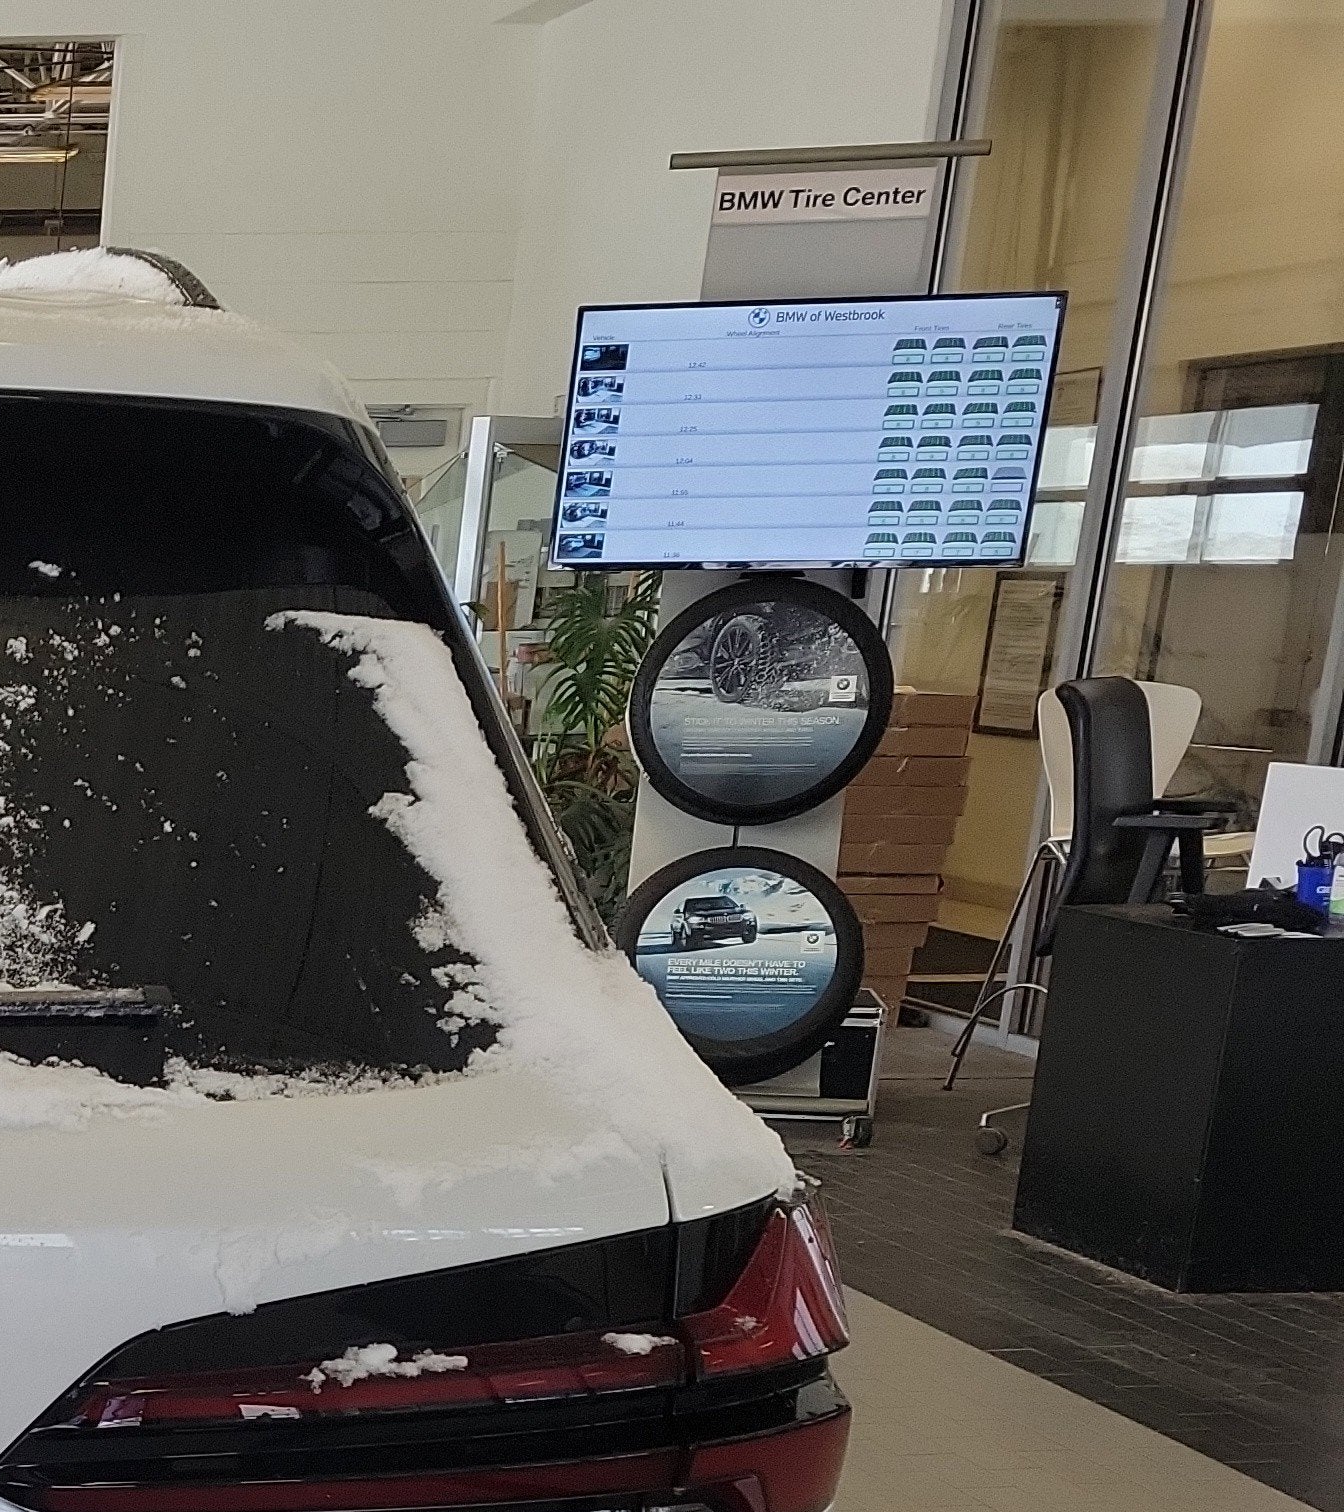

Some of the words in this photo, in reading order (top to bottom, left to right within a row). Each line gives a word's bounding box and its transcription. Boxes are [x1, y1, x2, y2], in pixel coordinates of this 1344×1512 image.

[719, 190, 785, 211] BMW
[789, 189, 835, 209] Tire
[842, 186, 927, 207] Center
[776, 311, 807, 322] BMW
[810, 310, 822, 322] of
[824, 309, 885, 321] Westbrook
[668, 958, 697, 966] EVERY
[699, 959, 722, 967] MILE
[723, 959, 763, 967] DOESN'T
[765, 960, 792, 968] HAVE
[793, 960, 806, 968] TO
[667, 966, 690, 974] FEEL
[714, 967, 736, 975] TWO
[737, 967, 759, 975] THIS
[760, 967, 799, 976] WINTER.
